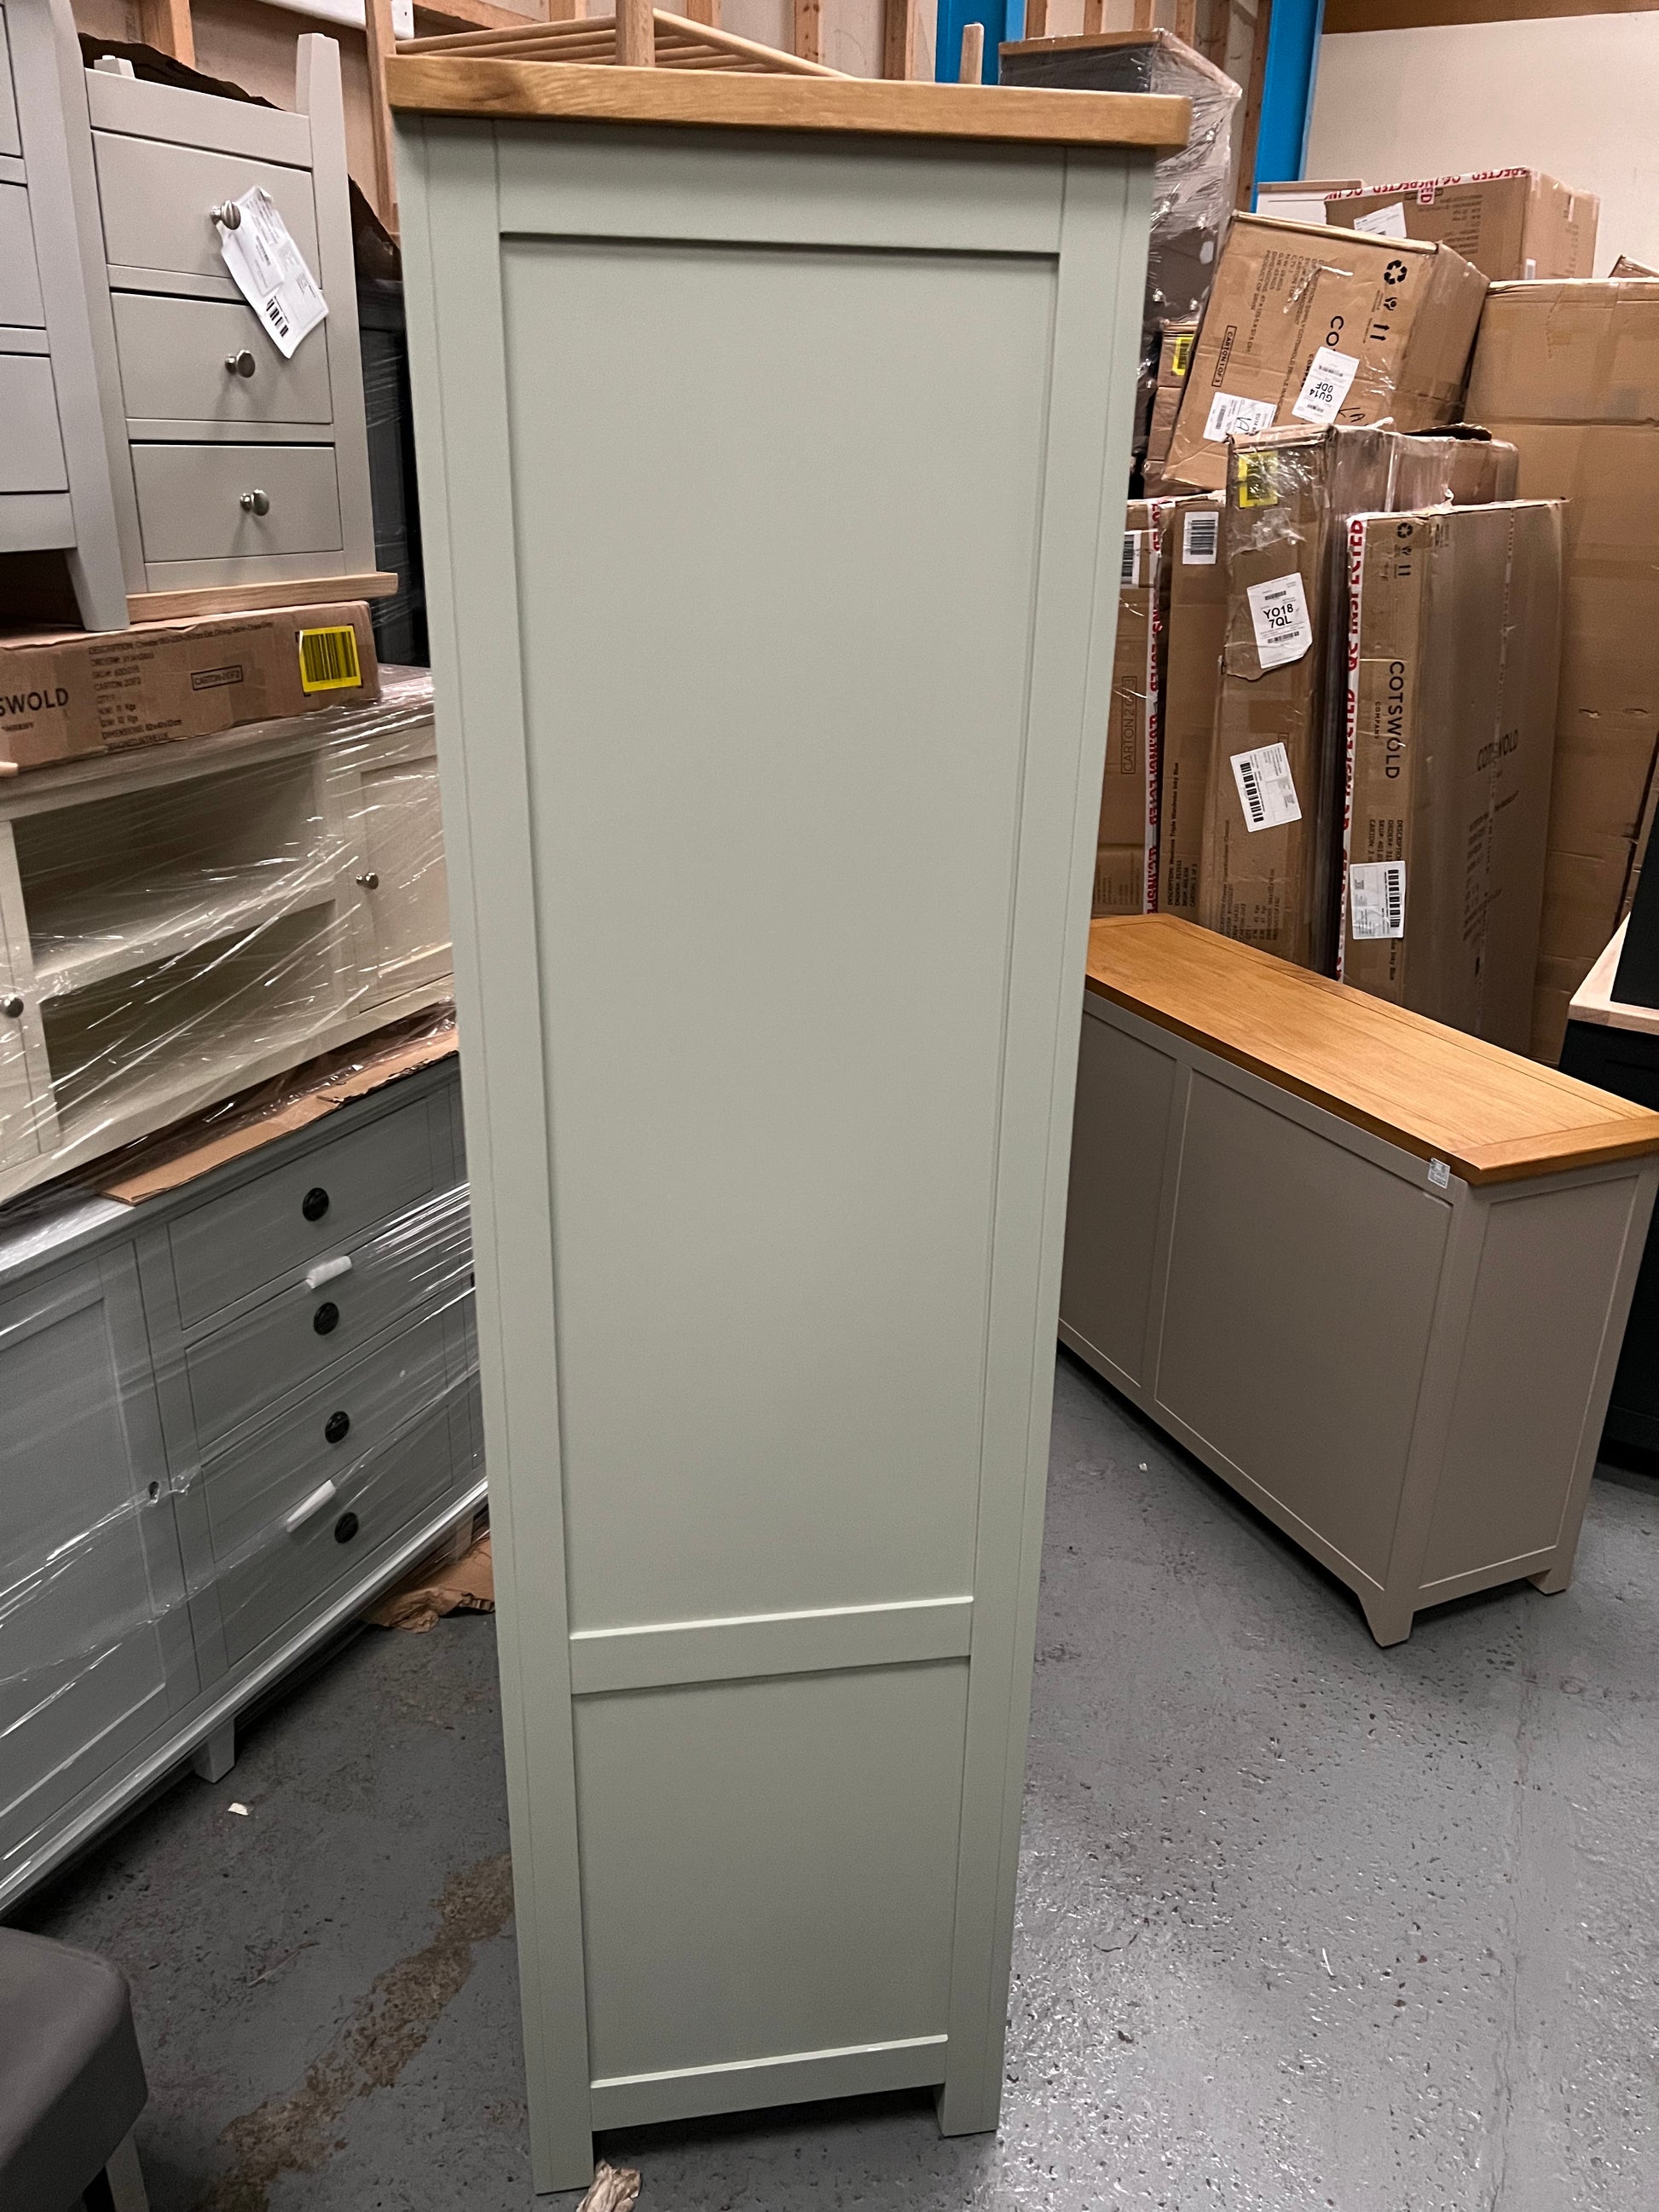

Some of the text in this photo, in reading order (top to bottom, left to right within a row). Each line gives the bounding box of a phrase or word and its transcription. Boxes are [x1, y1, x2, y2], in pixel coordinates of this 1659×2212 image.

[1309, 388, 1332, 402] GU14
[1263, 604, 1294, 620] YO18
[1269, 615, 1293, 628] 7QL
[1373, 701, 1382, 740] COMPANY
[1385, 661, 1406, 779] COTSWOLD
[1123, 719, 1135, 772] CARTON
